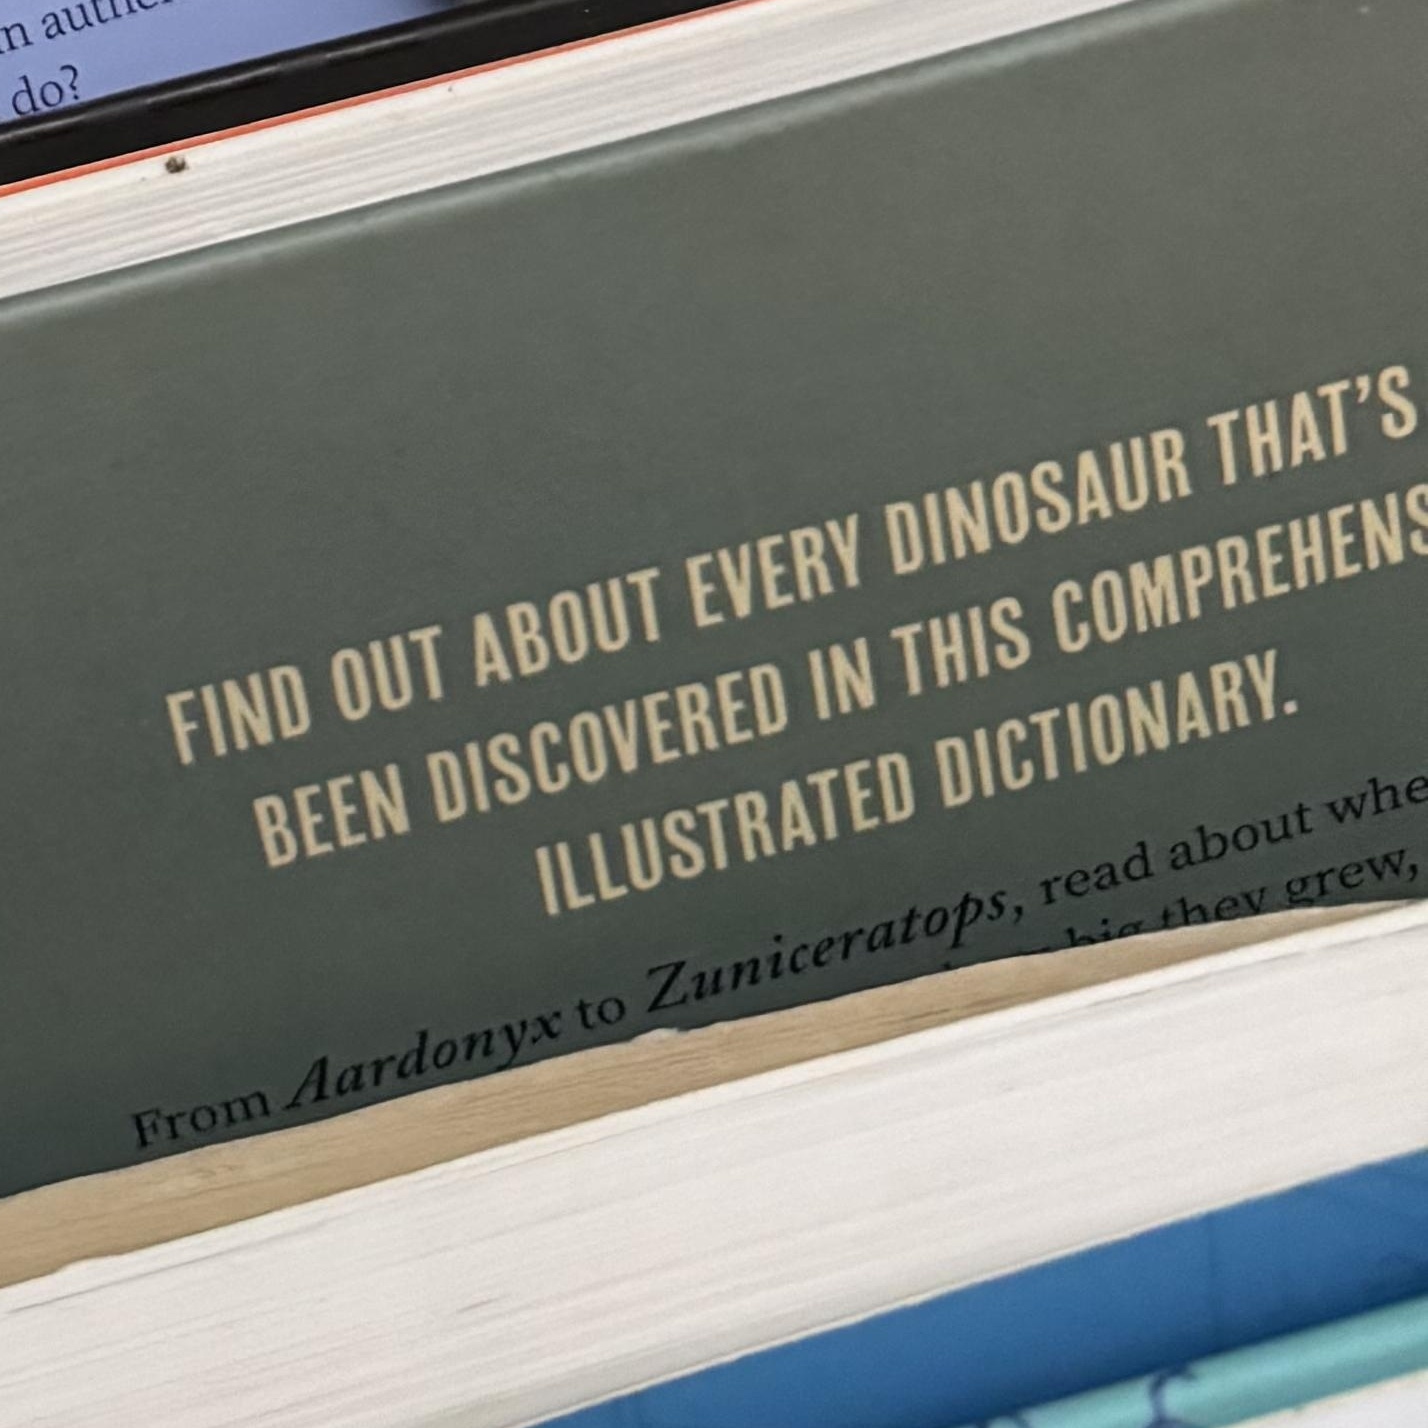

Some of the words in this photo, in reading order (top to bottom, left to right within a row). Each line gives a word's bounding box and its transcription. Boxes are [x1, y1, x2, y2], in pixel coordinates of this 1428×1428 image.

[12, 64, 80, 116] do?
[167, 665, 311, 765] FIND
[332, 626, 443, 722] OUT
[475, 567, 661, 687] ABOUT
[687, 513, 861, 627] EVERY
[886, 428, 1194, 575] DINOSAUR
[1207, 366, 1419, 487] THAT'S
[253, 763, 410, 867] BEEN
[427, 663, 787, 824] DISCOVERED
[809, 639, 876, 720] IN
[893, 597, 1032, 696] THIS
[535, 752, 916, 916] ILLUSTRATED
[936, 649, 1299, 810] DICTIONARY.
[131, 1089, 271, 1148] From
[286, 1009, 563, 1110] Aardonyx
[579, 996, 626, 1029] to
[647, 889, 1023, 1014] Zuniceratops,
[1040, 841, 1154, 905] read
[1170, 800, 1314, 871] about
[1285, 848, 1419, 907] grew,
